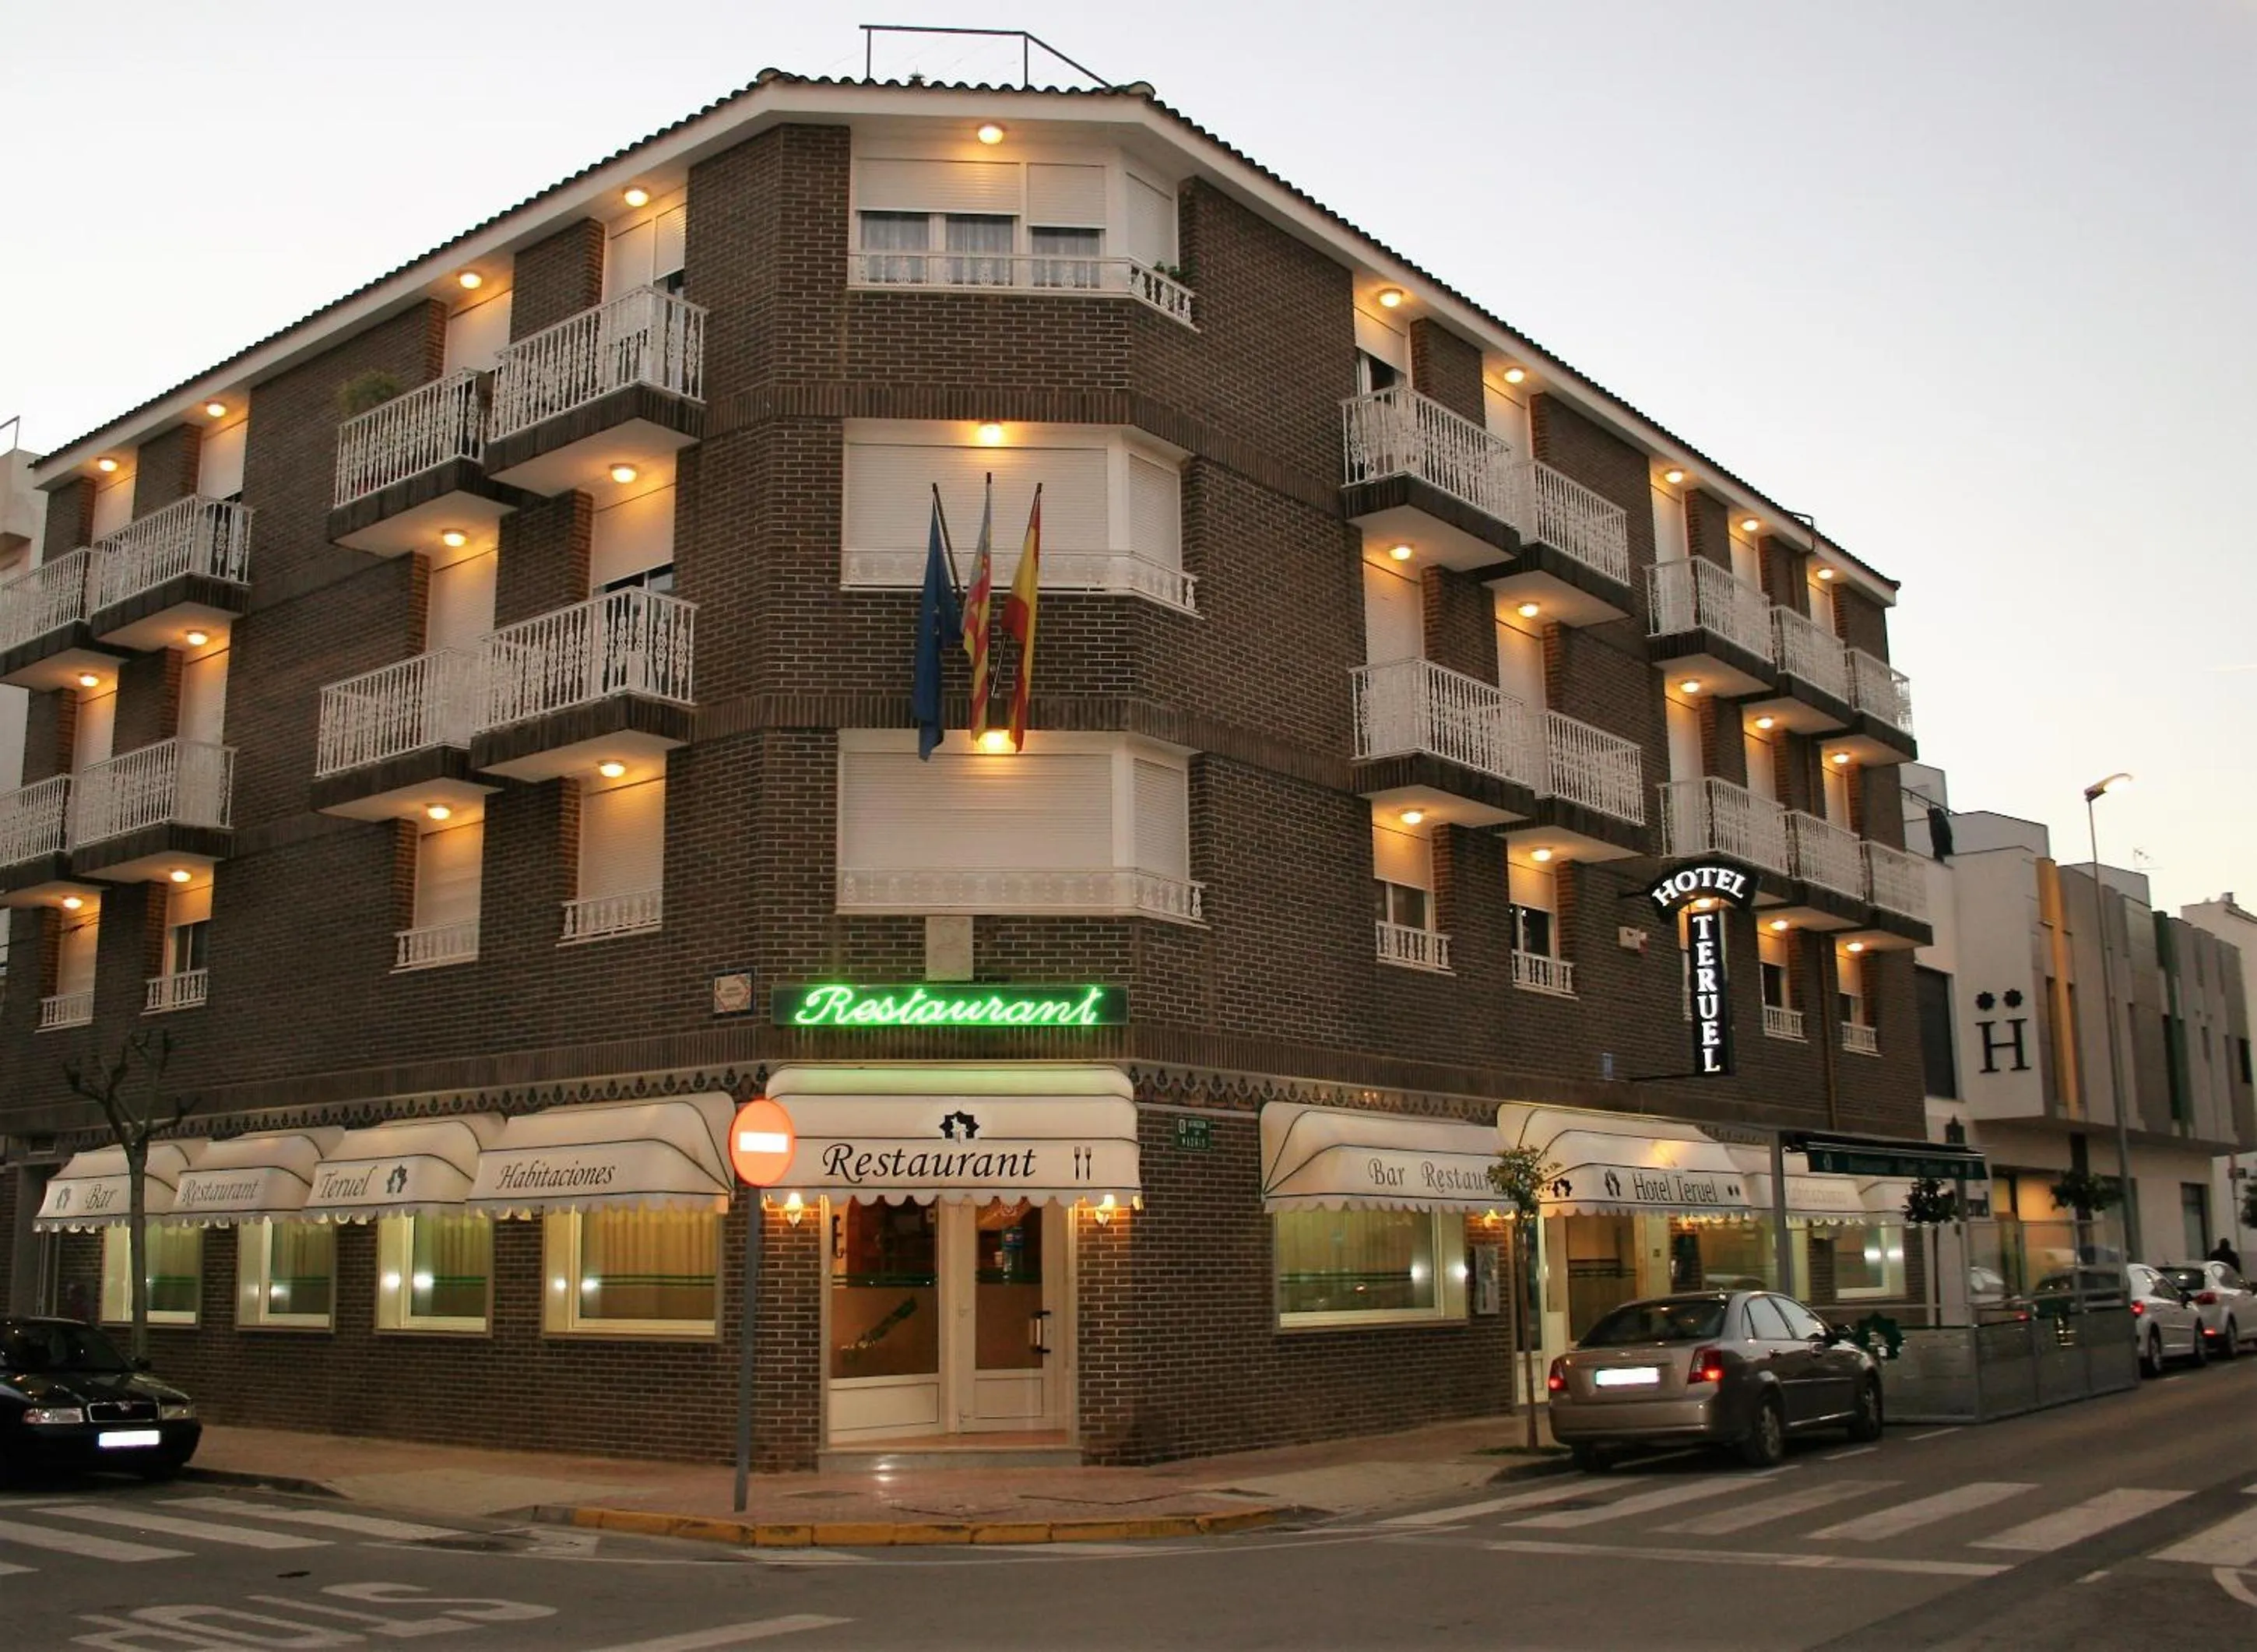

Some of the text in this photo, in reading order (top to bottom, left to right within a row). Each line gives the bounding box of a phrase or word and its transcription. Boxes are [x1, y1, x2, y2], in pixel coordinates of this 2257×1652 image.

[1651, 867, 1747, 907] HOTEL
[793, 985, 1103, 1025] Restaurant
[1692, 914, 1721, 1073] TERUEL
[495, 1160, 617, 1190] Habitaciones
[821, 1142, 1037, 1185] Restaurant
[1367, 1158, 1405, 1186] Bar
[84, 1183, 118, 1210] Bar
[181, 1177, 259, 1206] Restaurant
[319, 1165, 378, 1199] Teruel
[1632, 1172, 1719, 1203] Hotel Teruel
